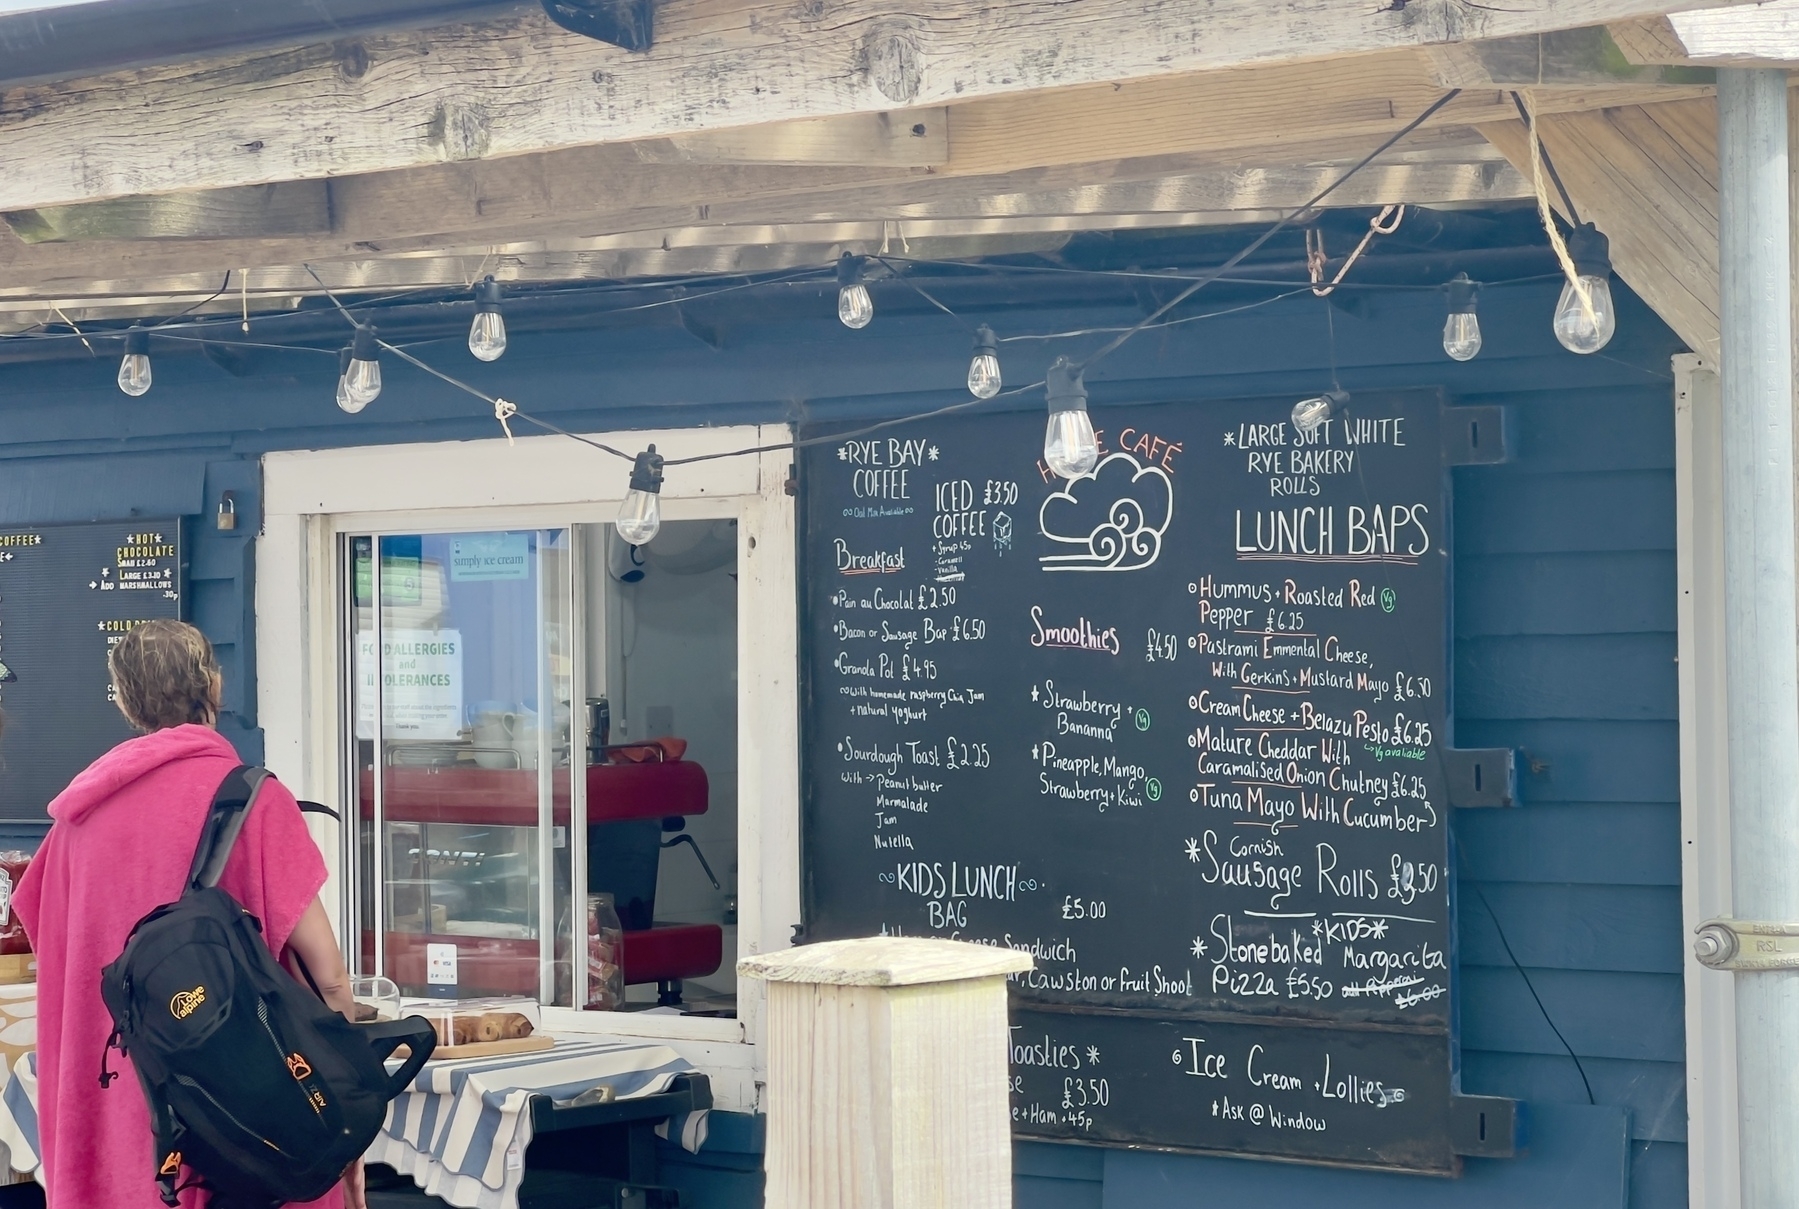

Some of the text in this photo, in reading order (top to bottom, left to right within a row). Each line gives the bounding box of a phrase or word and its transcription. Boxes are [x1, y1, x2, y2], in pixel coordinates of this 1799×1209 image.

[1238, 422, 1287, 449] LARGE
[1344, 418, 1406, 447] WHITE
[846, 438, 926, 468] RYE BAY
[1120, 428, 1183, 474] CAFÉ
[1248, 449, 1354, 475] RYE BAKERY
[853, 468, 910, 499] COFFEE
[935, 479, 1019, 512] ICED £3.50
[1270, 476, 1320, 497] ROLLS
[136, 533, 154, 544] HOT
[933, 510, 987, 539] COFFEE
[1236, 503, 1429, 555] LUNCH BAPS
[117, 545, 174, 558] CHOCOLATE
[454, 555, 524, 569] simply ice cream
[833, 538, 905, 573] Breakfast
[838, 584, 956, 611] Pain au Chocolat £2.50
[1200, 574, 1272, 603] Hummus
[1284, 578, 1344, 609] Roasted
[1349, 578, 1376, 609] Red
[107, 620, 132, 631] COLD
[838, 615, 986, 650] Bacon or Sausage Bap £6.50
[1198, 599, 1304, 634] Pepper £6.25
[393, 642, 455, 656] ALLERGIES
[1030, 605, 1178, 662] Smoothies £4.50
[399, 659, 416, 669] and
[878, 652, 894, 679] Pot
[902, 653, 937, 681] £4.95
[1197, 632, 1374, 669] Pastrami Emmental Cheese,
[869, 686, 907, 701] homemade
[910, 688, 947, 709] raspberry
[966, 688, 985, 704] Jam
[1212, 661, 1237, 680] With
[1300, 666, 1354, 691] Mustard
[1357, 672, 1390, 704] Mayo
[891, 705, 928, 725] yoghurt
[1043, 679, 1121, 729] Strawberry
[1198, 692, 1241, 717] Cream
[1242, 694, 1286, 725] Cheese
[1300, 702, 1352, 737] Belazu
[1353, 709, 1389, 744] Pesto
[1391, 712, 1433, 747] £6.25
[1057, 711, 1113, 743] Bananna
[844, 735, 990, 776] Sourdough Toast £2.25
[1197, 724, 1350, 766] Mature Cheddar With
[876, 773, 910, 791] Peanut
[911, 775, 943, 792] butter
[1039, 771, 1109, 813] Strawberry
[1286, 761, 1326, 788] Onion
[1328, 766, 1388, 807] Chutney
[1391, 771, 1427, 800] £6.25
[876, 794, 929, 813] Marmalade
[1196, 783, 1428, 836] Tuna Mayo With Cucumber
[874, 812, 897, 829] Jam
[874, 833, 914, 850] Nutella
[1229, 835, 1285, 857] Cornish
[897, 861, 1017, 902] KIDS LUNCH
[1201, 829, 1302, 910] Sausage
[1316, 842, 1380, 900] Rolls
[927, 895, 1107, 929] BAG £5.00
[1210, 913, 1323, 966] Stonebaked
[1756, 940, 1783, 953] RSL
[1028, 966, 1097, 992] Cawston
[1100, 976, 1117, 990] or
[1153, 964, 1193, 996] Shoot
[1212, 964, 1280, 996] Pizza
[1286, 967, 1333, 1000] £5.50
[179, 994, 206, 1018] alpine
[1182, 1037, 1228, 1079] Ice
[1247, 1044, 1302, 1091] Cream
[1061, 1076, 1109, 1109] £3.50
[1249, 1103, 1265, 1126] @
[1269, 1104, 1327, 1132] Window
